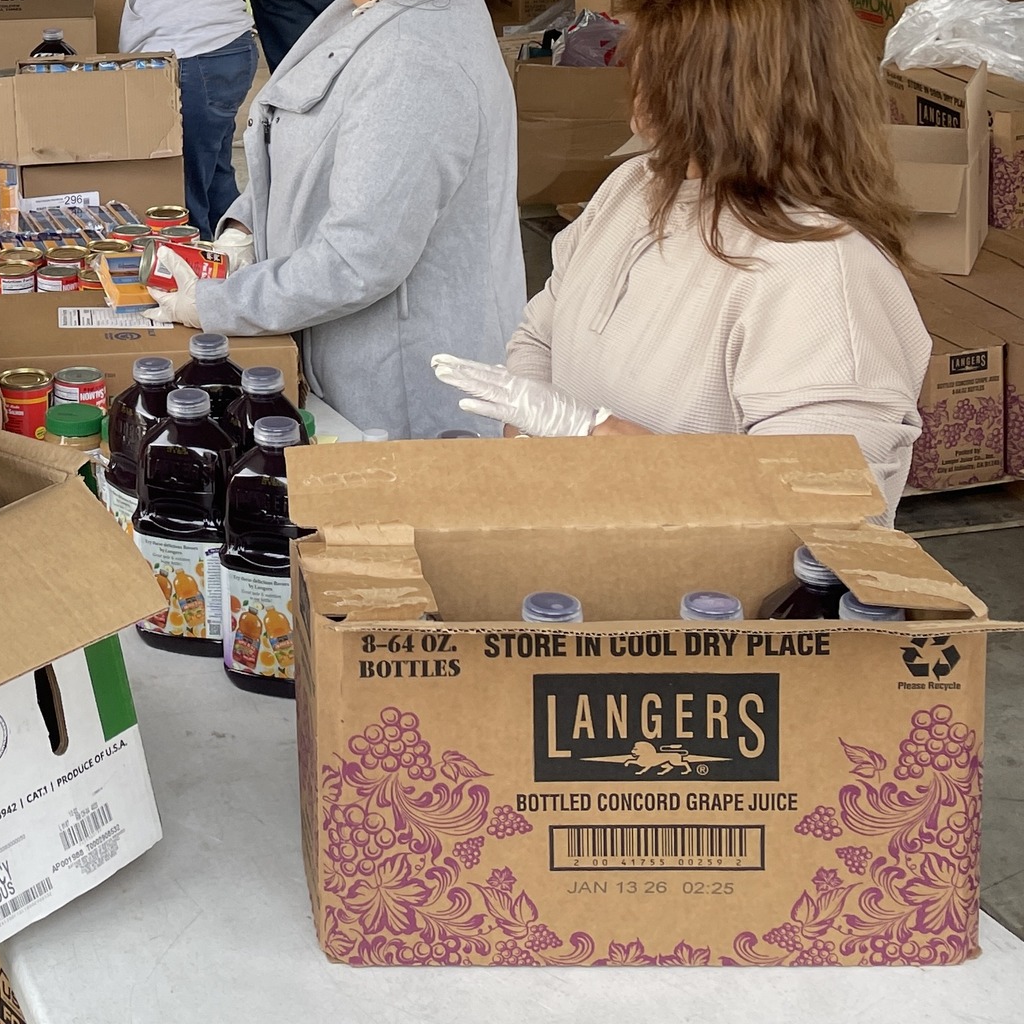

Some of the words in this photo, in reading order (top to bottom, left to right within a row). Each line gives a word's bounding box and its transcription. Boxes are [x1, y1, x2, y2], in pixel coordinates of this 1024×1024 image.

[918, 102, 959, 128] LANGERS
[64, 195, 83, 205] 296
[951, 354, 986, 371] LANGERS
[79, 389, 104, 401] SALMON
[421, 633, 458, 653] OZ.
[484, 633, 567, 658] STORE
[576, 634, 601, 656] IN
[610, 633, 677, 657] COOL
[685, 632, 737, 657] DRY
[747, 632, 831, 656] PLACE
[359, 658, 461, 678] BOTTLES
[897, 681, 926, 691] Please
[928, 681, 962, 692] Recycle
[546, 692, 766, 758] LANGERS
[56, 759, 94, 788] PRODUCE
[94, 752, 105, 764] OF
[105, 739, 128, 757] U.S.A.
[516, 793, 592, 812] BOTTLED
[597, 793, 681, 812] CONCORD
[686, 792, 744, 812] GRAPE
[748, 792, 798, 812] JUICE
[573, 858, 580, 866] 2
[621, 858, 665, 866] 41755
[678, 858, 723, 866] 00259
[735, 858, 742, 866] 2
[567, 881, 608, 894] JAN
[616, 881, 638, 894] 13
[644, 881, 667, 894] 26
[682, 881, 735, 895] 02:25
